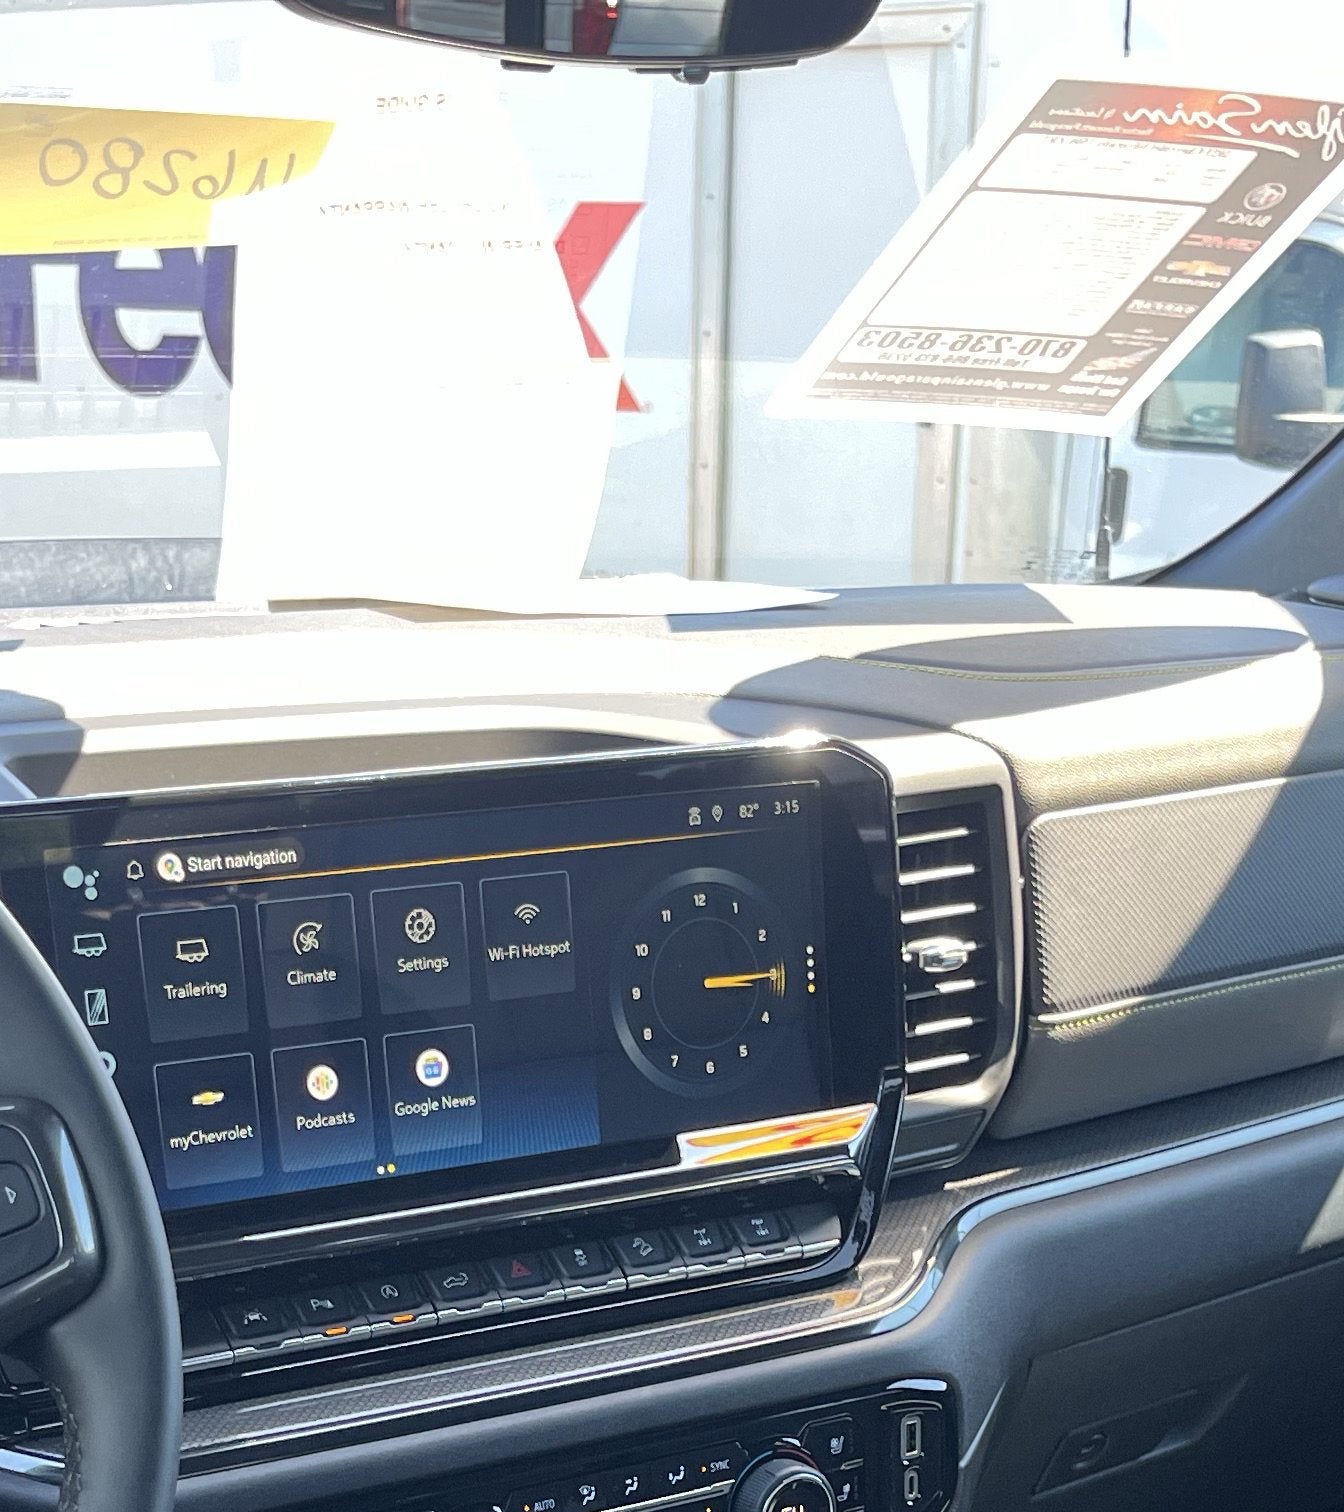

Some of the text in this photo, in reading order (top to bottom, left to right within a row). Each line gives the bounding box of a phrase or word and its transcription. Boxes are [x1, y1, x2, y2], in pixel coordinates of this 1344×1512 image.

[738, 802, 759, 819] 82°
[774, 799, 800, 816] 3:15
[187, 847, 298, 874] Start navigation
[693, 893, 707, 907] 12
[732, 901, 739, 914] 1
[660, 908, 672, 922] 11
[758, 928, 767, 942] 2
[488, 938, 571, 963] Wi-Fi Hotspot
[634, 943, 649, 957] 10
[397, 955, 449, 976] Settings
[287, 967, 337, 987] Climate
[163, 981, 228, 1001] Trailering
[631, 986, 641, 1001] 9
[761, 1010, 771, 1024] 4
[642, 1026, 653, 1041] 8
[738, 1044, 748, 1058] 5
[670, 1054, 679, 1068] 7
[705, 1060, 715, 1074] 6
[394, 1093, 477, 1119] Google News
[296, 1111, 356, 1131] Podcasts
[169, 1124, 254, 1151] myChevrolet
[709, 1458, 731, 1474] SYNC
[534, 1498, 556, 1512] AUTO
